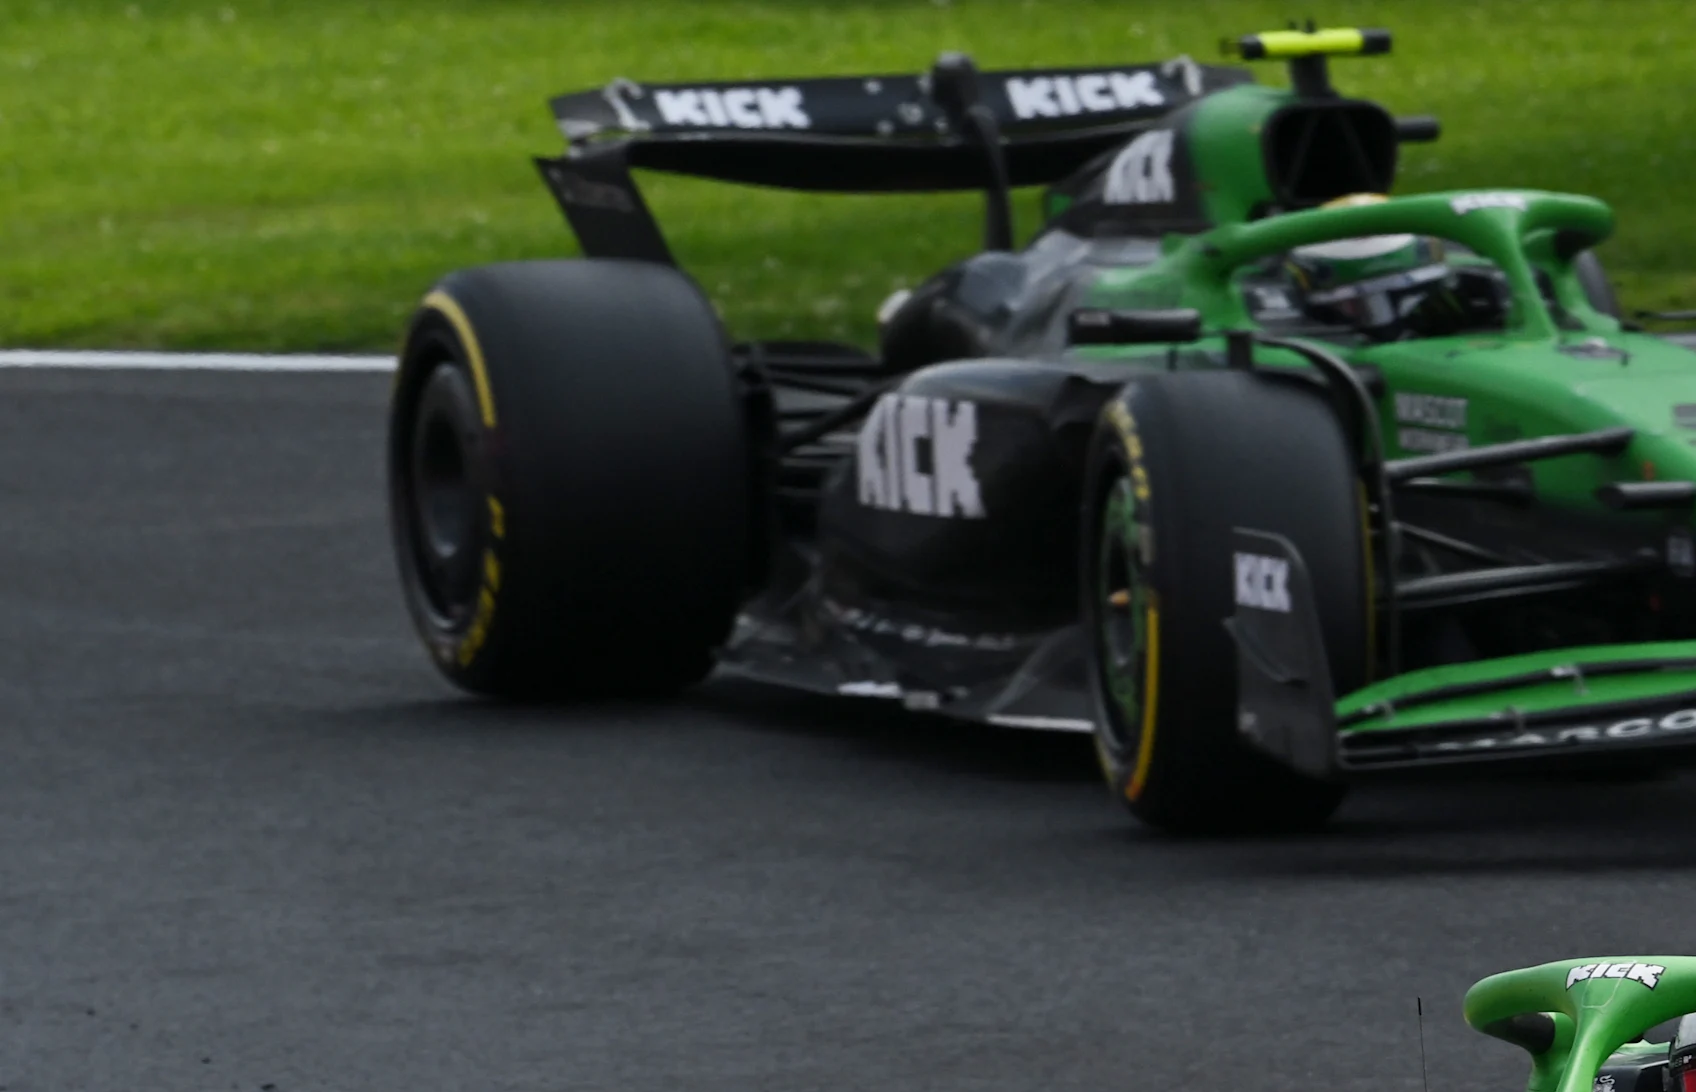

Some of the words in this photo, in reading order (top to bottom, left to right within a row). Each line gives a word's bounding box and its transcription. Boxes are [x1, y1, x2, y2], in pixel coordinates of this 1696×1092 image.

[655, 87, 810, 129] KICK
[1006, 72, 1166, 120] KICK
[856, 393, 987, 519] KICK
[1233, 551, 1291, 613] KICK
[1565, 961, 1666, 990] KICK
